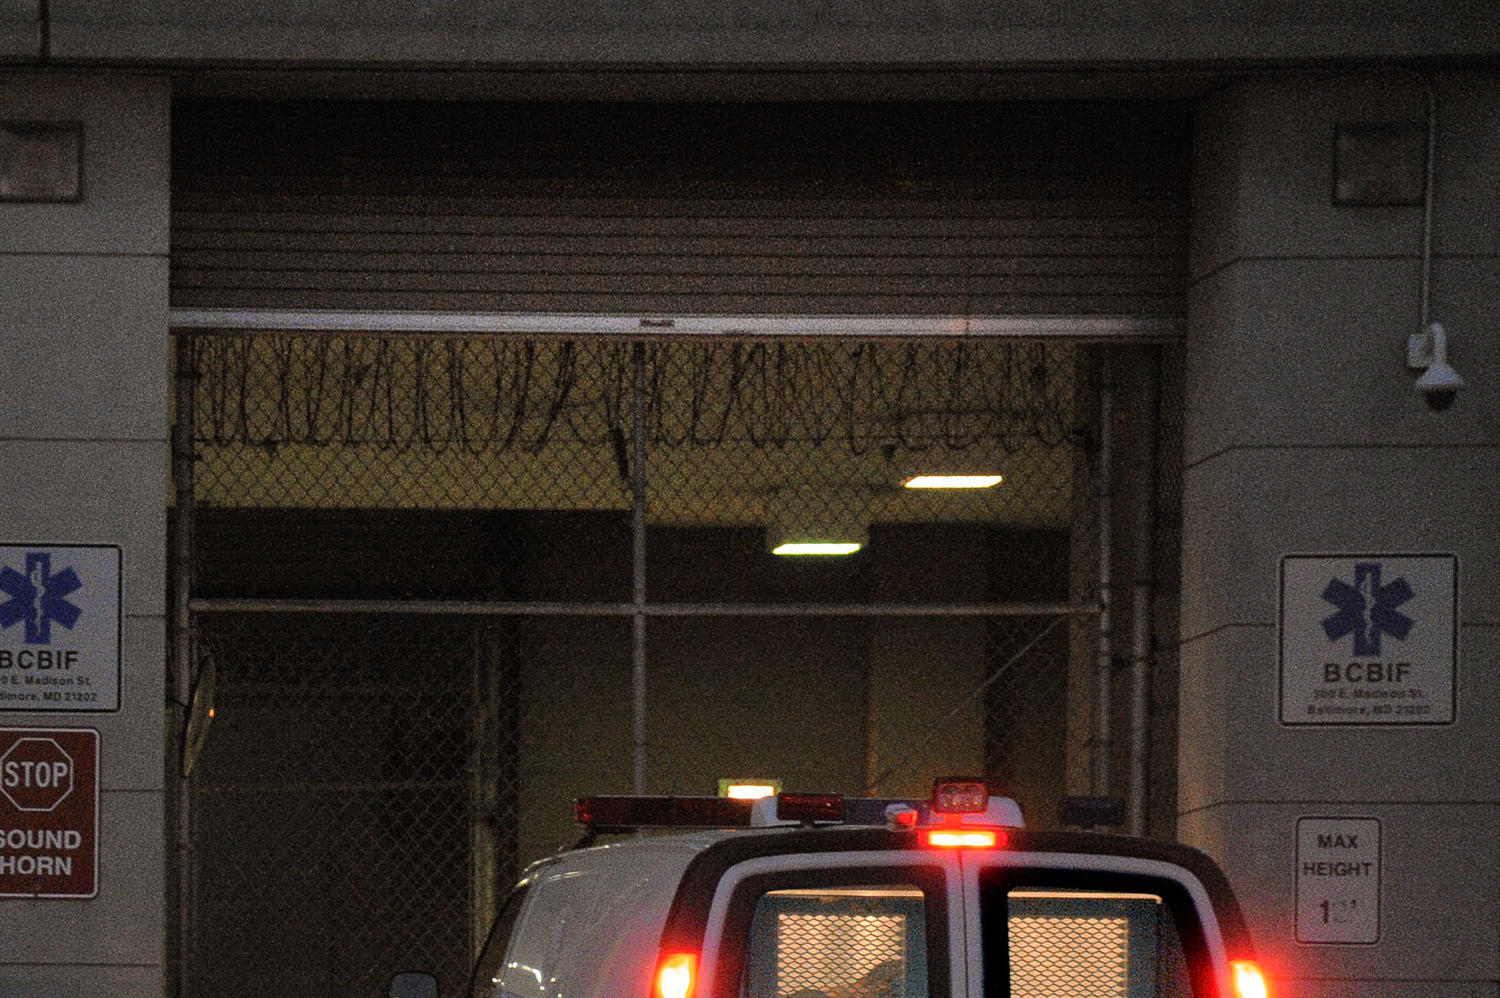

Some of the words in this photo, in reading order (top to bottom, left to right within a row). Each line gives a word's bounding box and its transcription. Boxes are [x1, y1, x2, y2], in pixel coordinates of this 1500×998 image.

[1324, 663, 1410, 682] BCBIF
[24, 676, 73, 686] Madison
[43, 691, 62, 702] MD
[64, 692, 98, 702] 21202
[4, 761, 68, 788] STOP
[1317, 833, 1358, 849] MAX
[1303, 861, 1372, 877] HEIGHT
